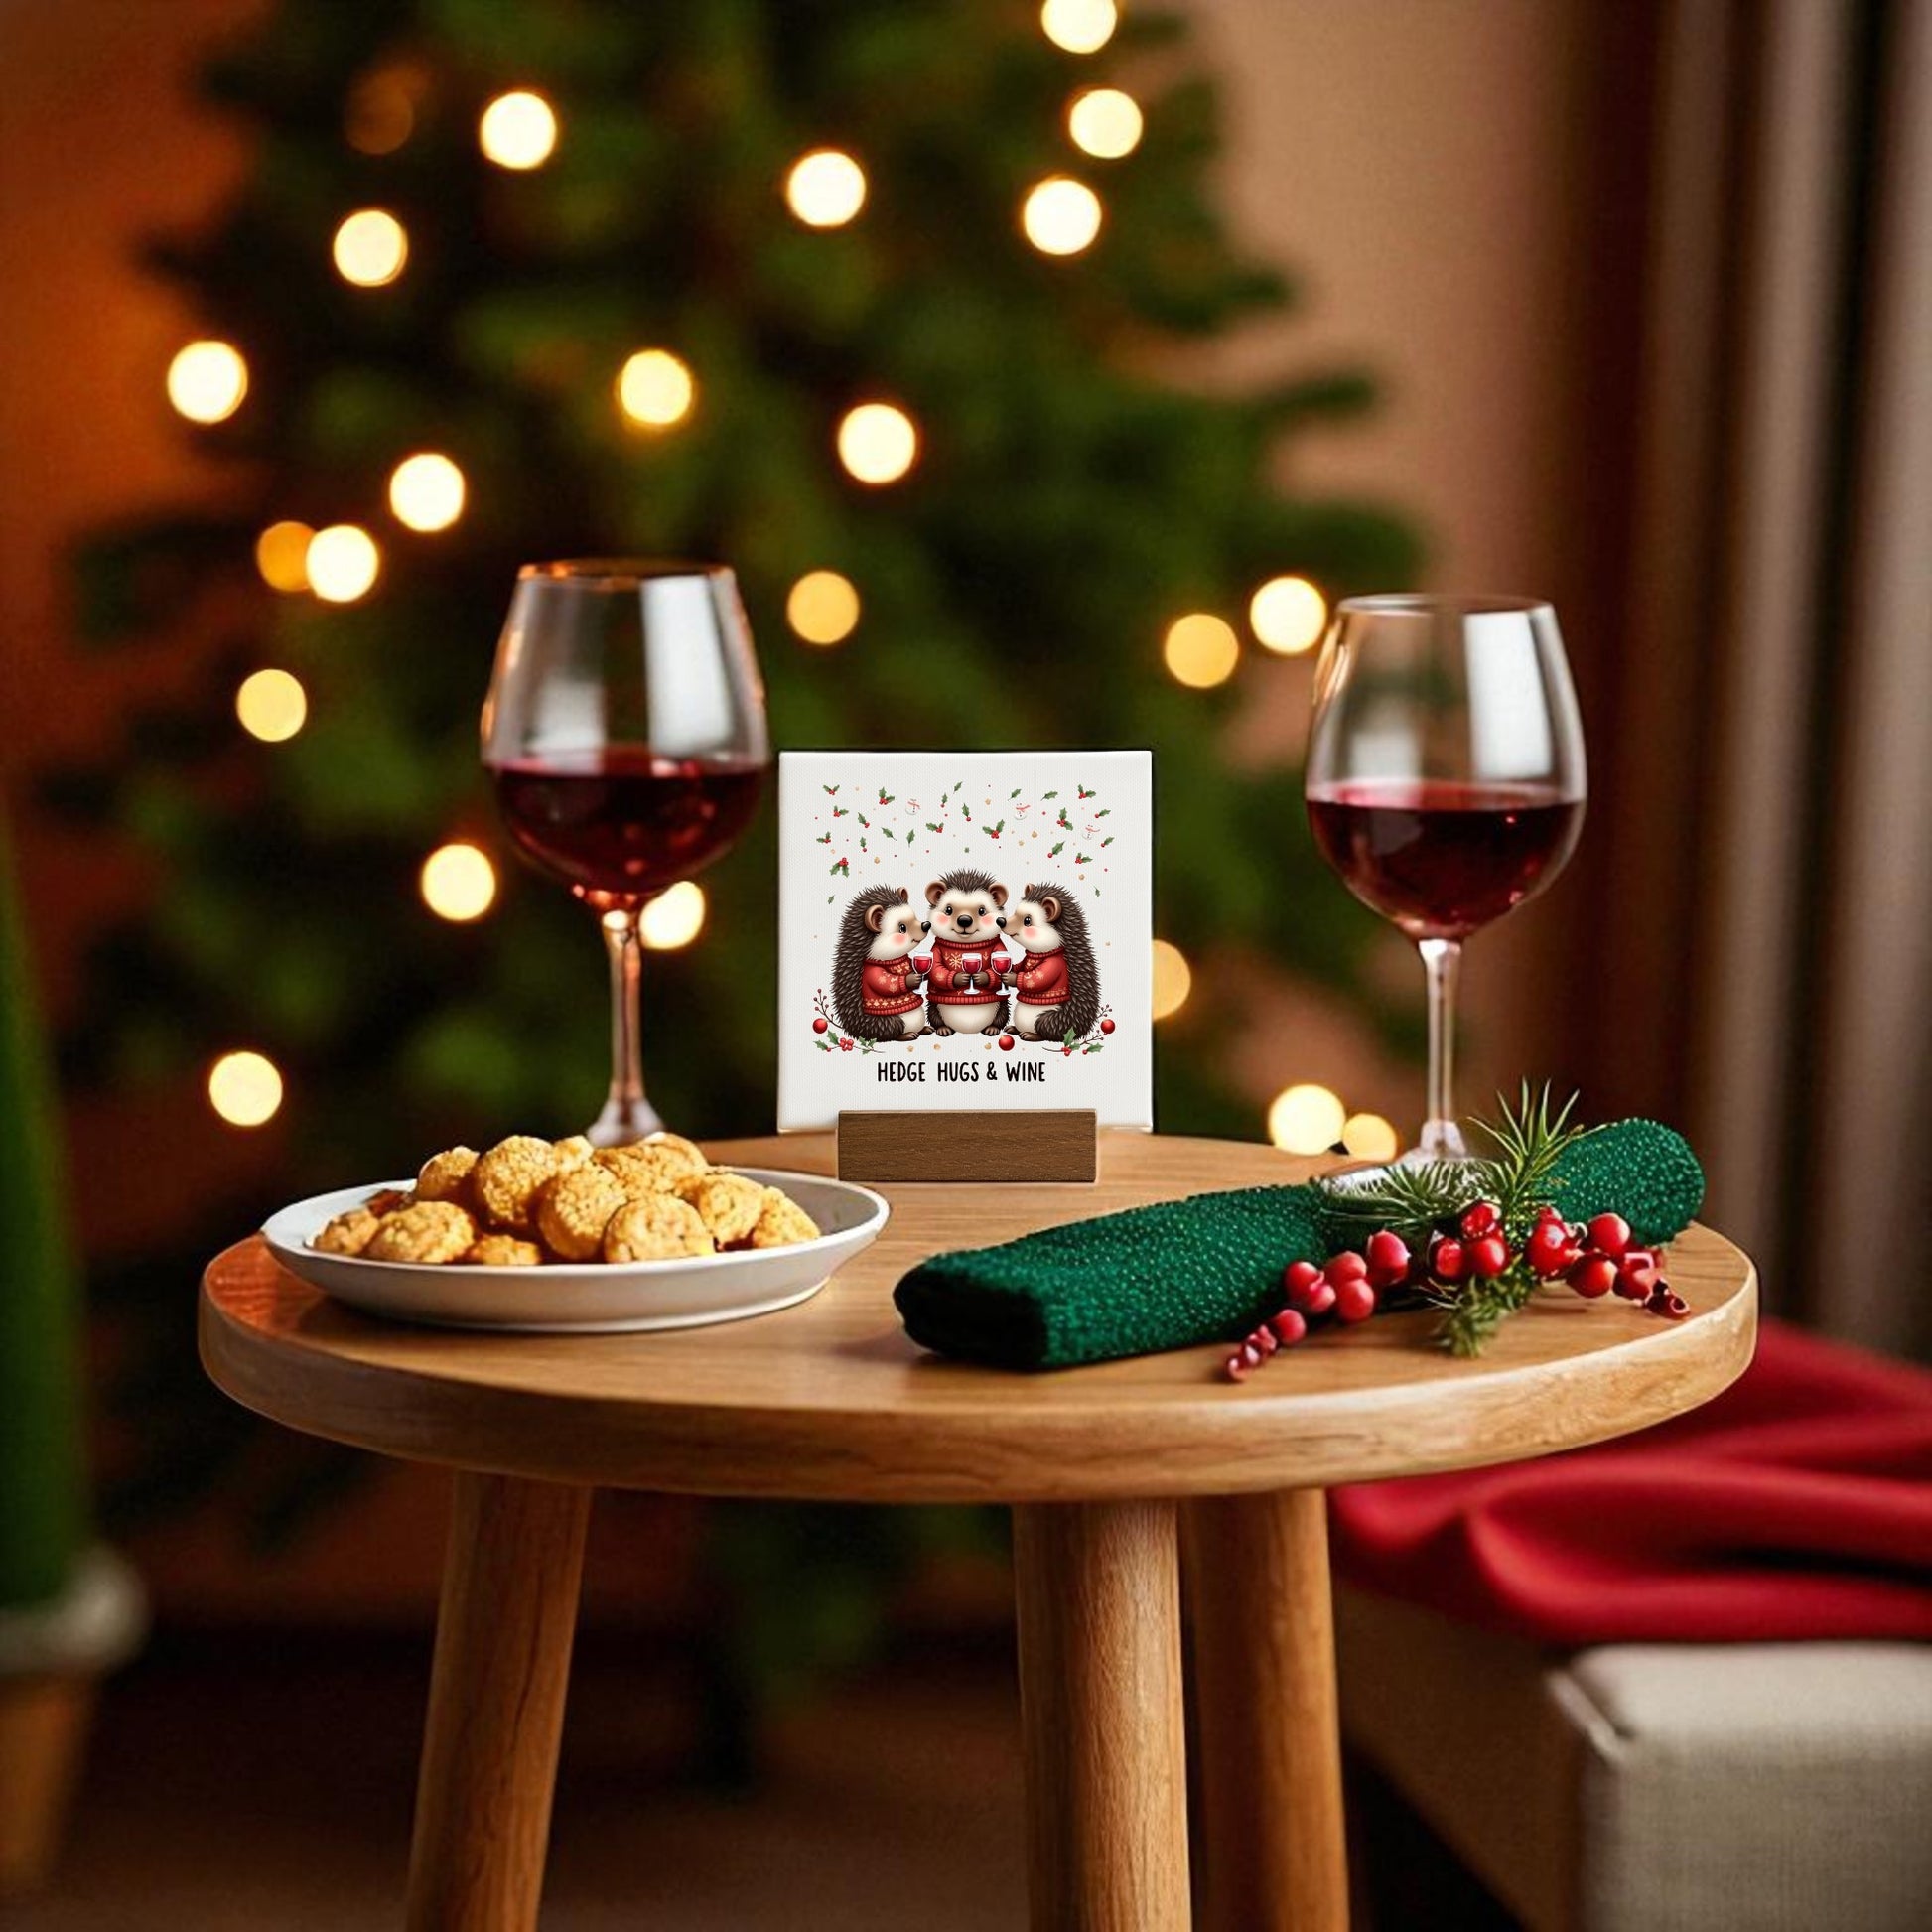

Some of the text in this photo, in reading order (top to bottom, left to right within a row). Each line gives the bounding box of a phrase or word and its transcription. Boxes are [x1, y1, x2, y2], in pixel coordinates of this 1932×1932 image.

[877, 1060, 1046, 1082] HEDGE HUGS & WINE
